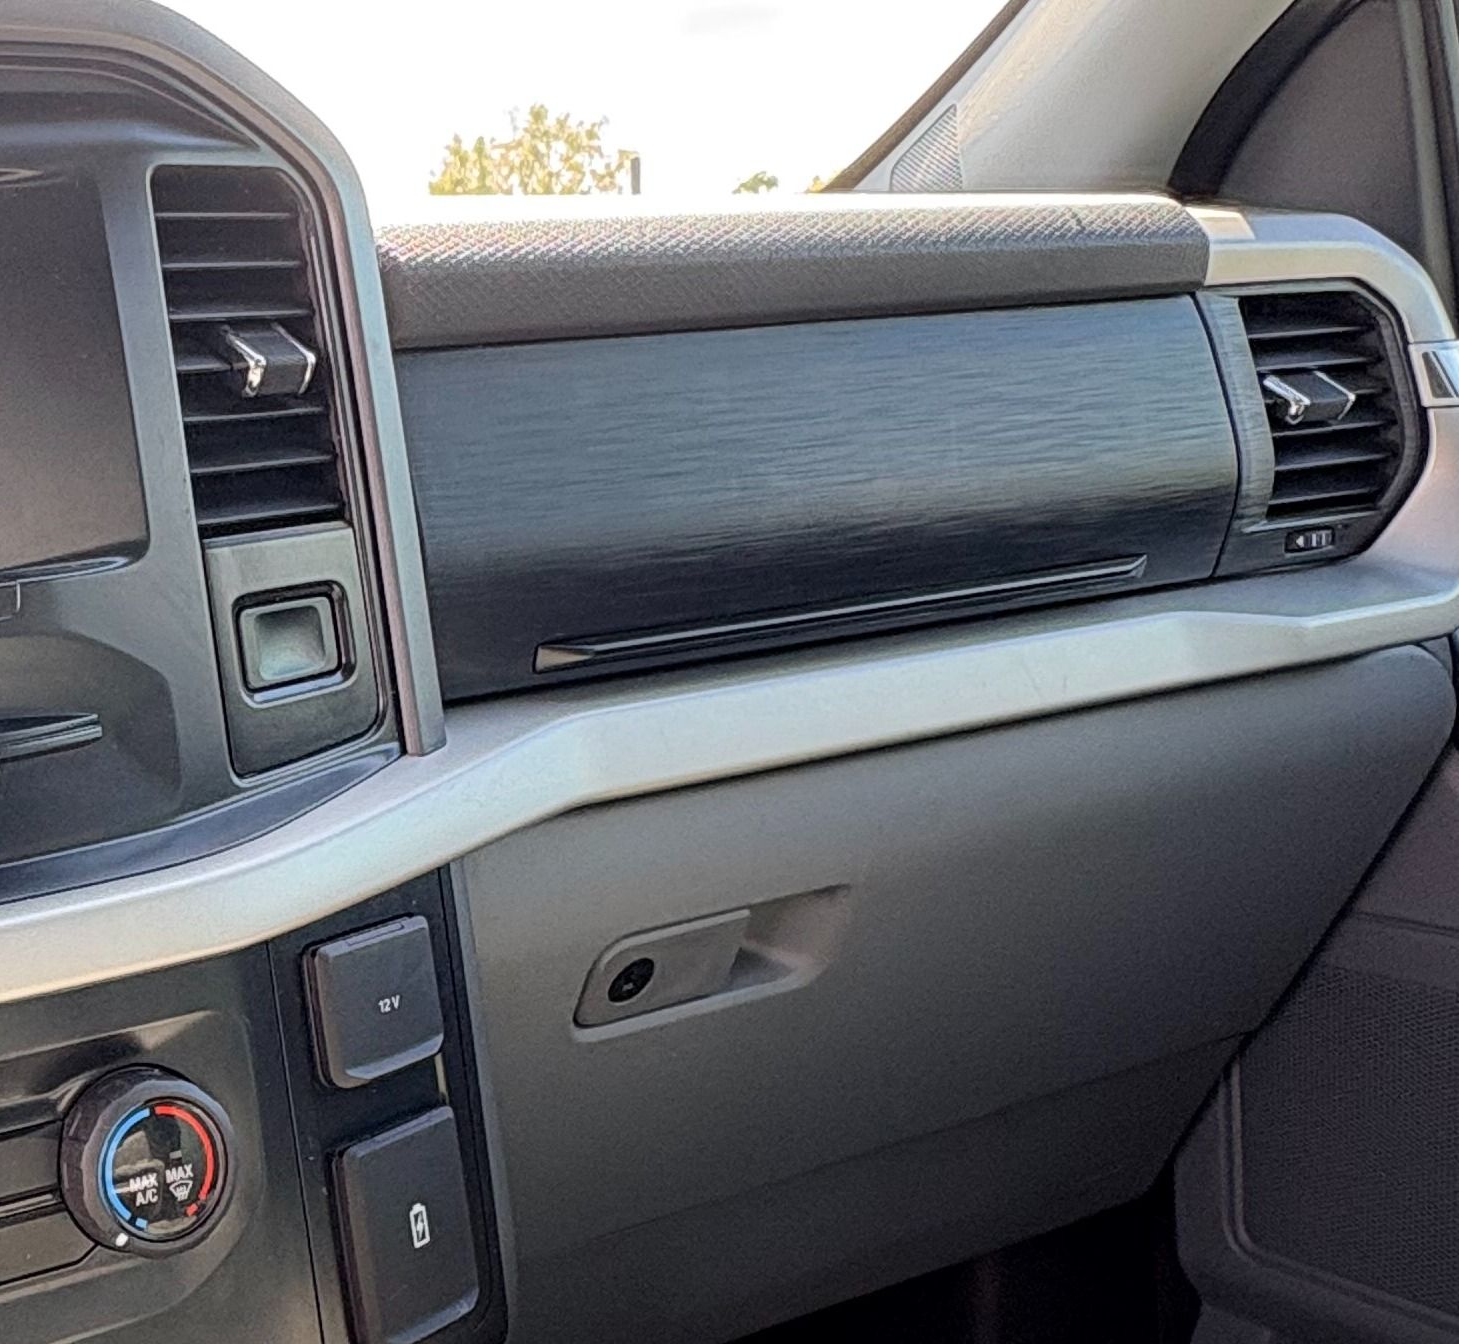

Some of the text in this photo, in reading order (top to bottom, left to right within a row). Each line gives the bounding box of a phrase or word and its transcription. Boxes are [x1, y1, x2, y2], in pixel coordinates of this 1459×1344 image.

[129, 1172, 159, 1192] MAX
[165, 1163, 194, 1183] MAX
[135, 1188, 159, 1207] A/C
